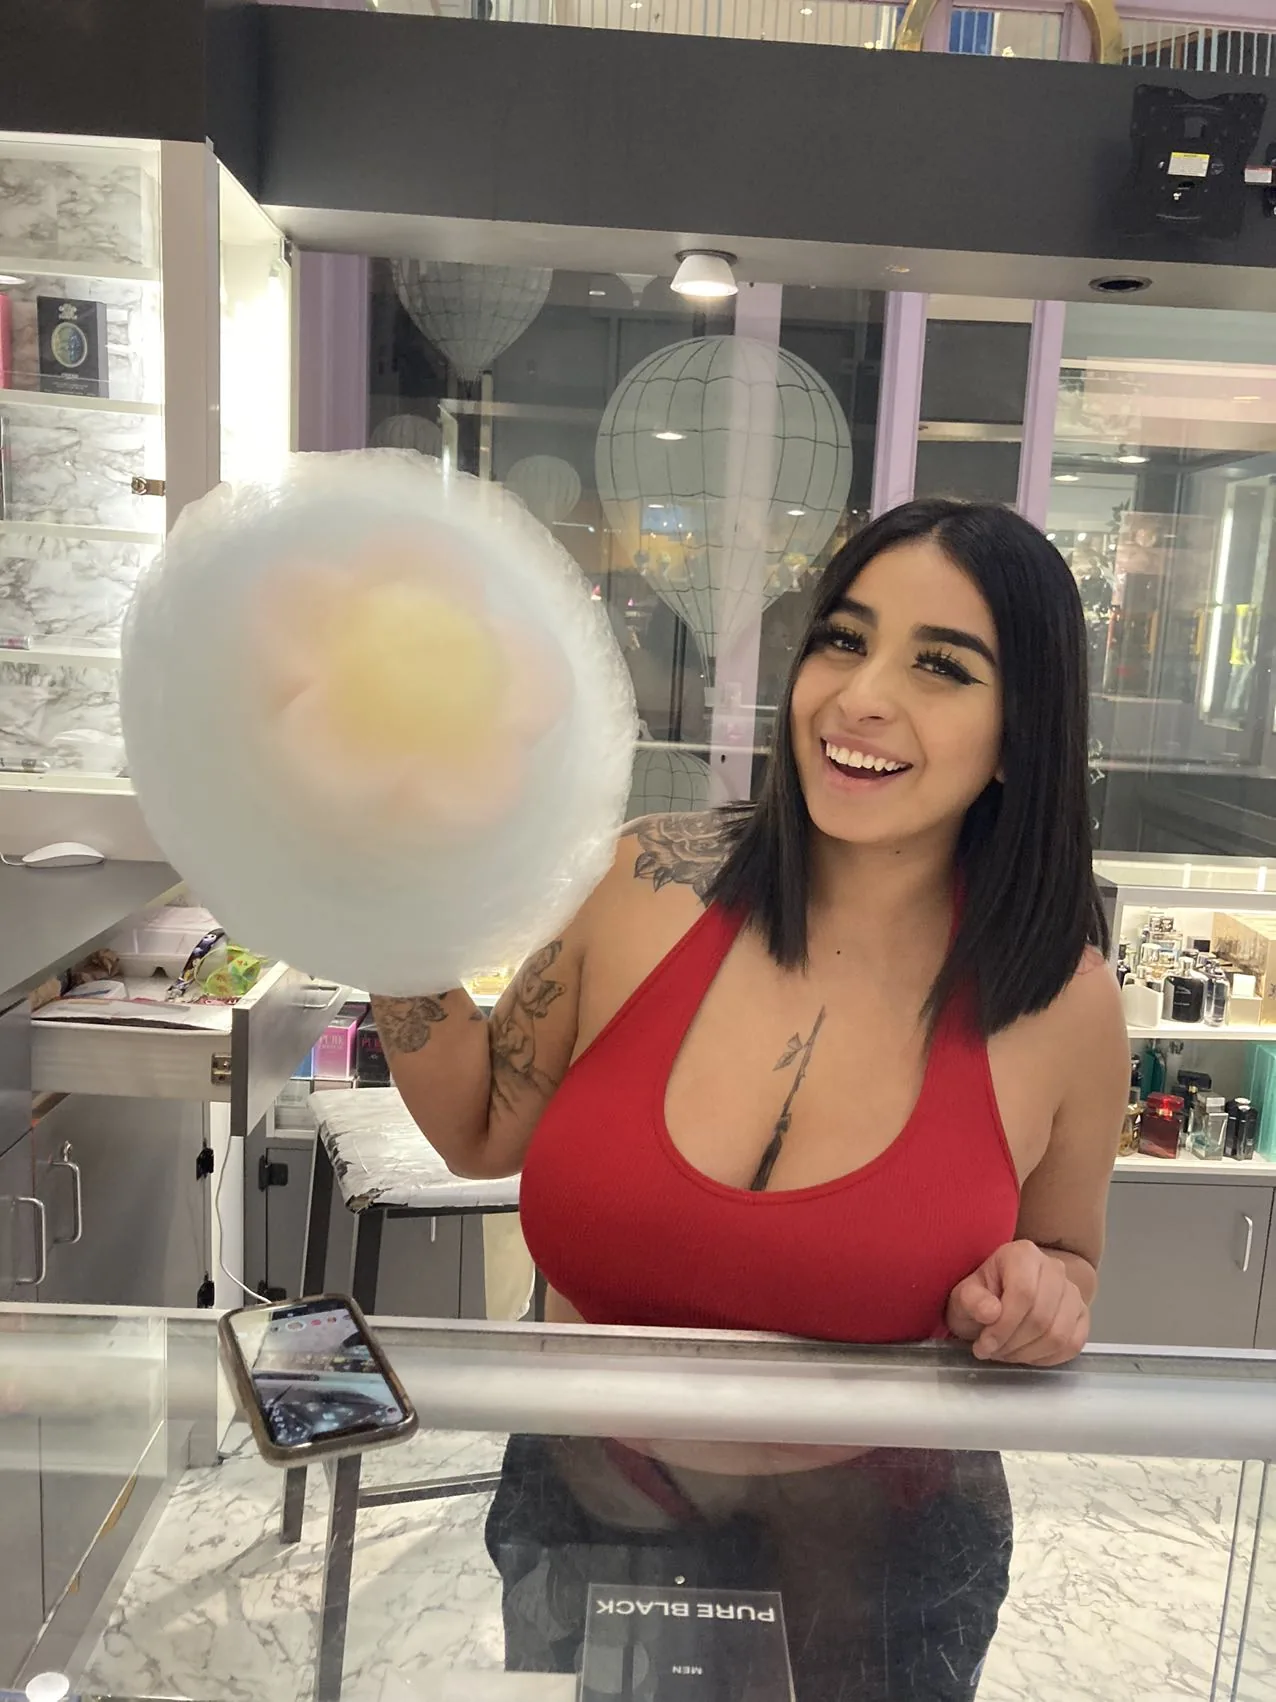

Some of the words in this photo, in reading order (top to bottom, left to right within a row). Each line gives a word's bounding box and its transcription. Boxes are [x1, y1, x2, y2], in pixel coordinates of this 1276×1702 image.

[596, 1599, 690, 1617] BLACK
[696, 1604, 776, 1622] PURE
[672, 1664, 703, 1675] MEN
